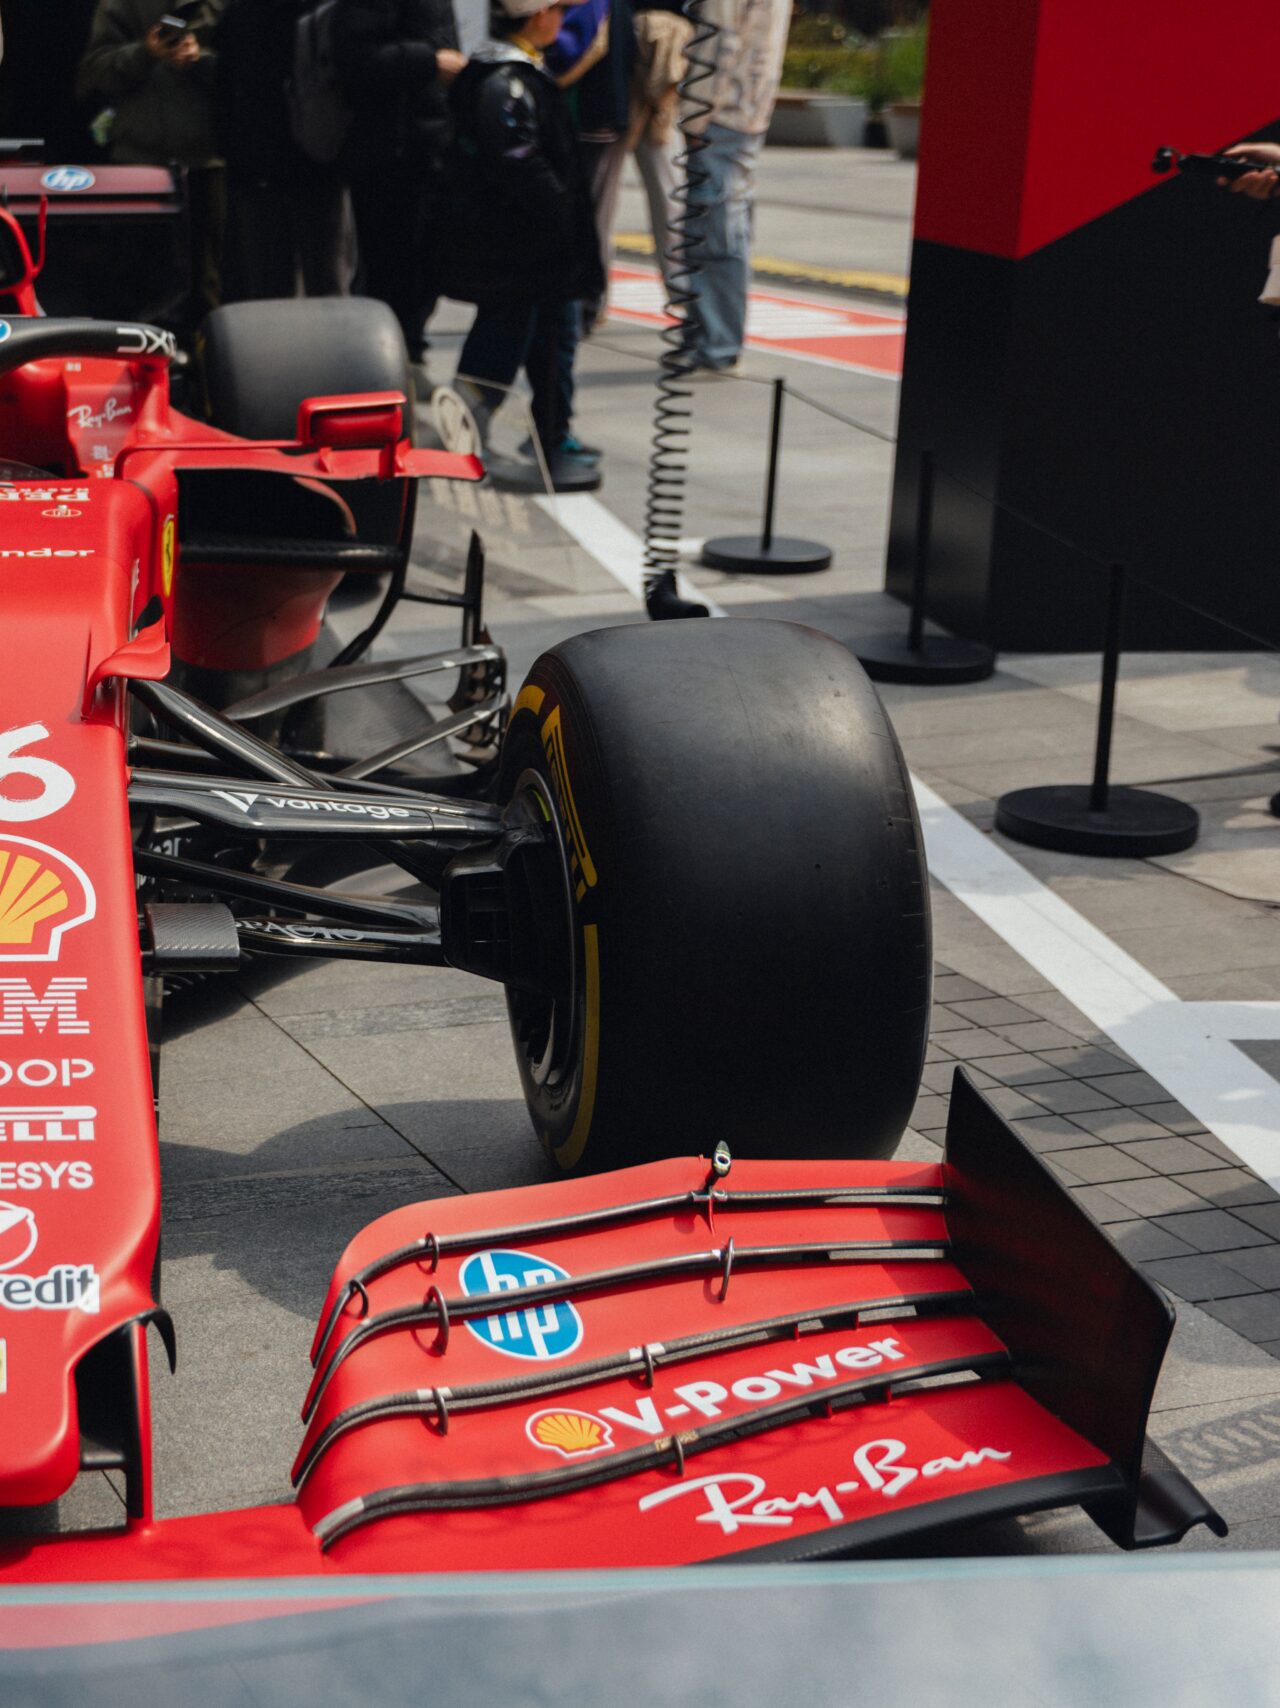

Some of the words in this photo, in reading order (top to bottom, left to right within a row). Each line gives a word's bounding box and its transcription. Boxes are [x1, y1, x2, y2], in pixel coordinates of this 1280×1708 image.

[51, 166, 89, 190] hp
[266, 797, 410, 820] vantage
[480, 1252, 560, 1357] hp
[602, 1335, 907, 1436] V-Power
[639, 1438, 1012, 1535] Ray-Ban
